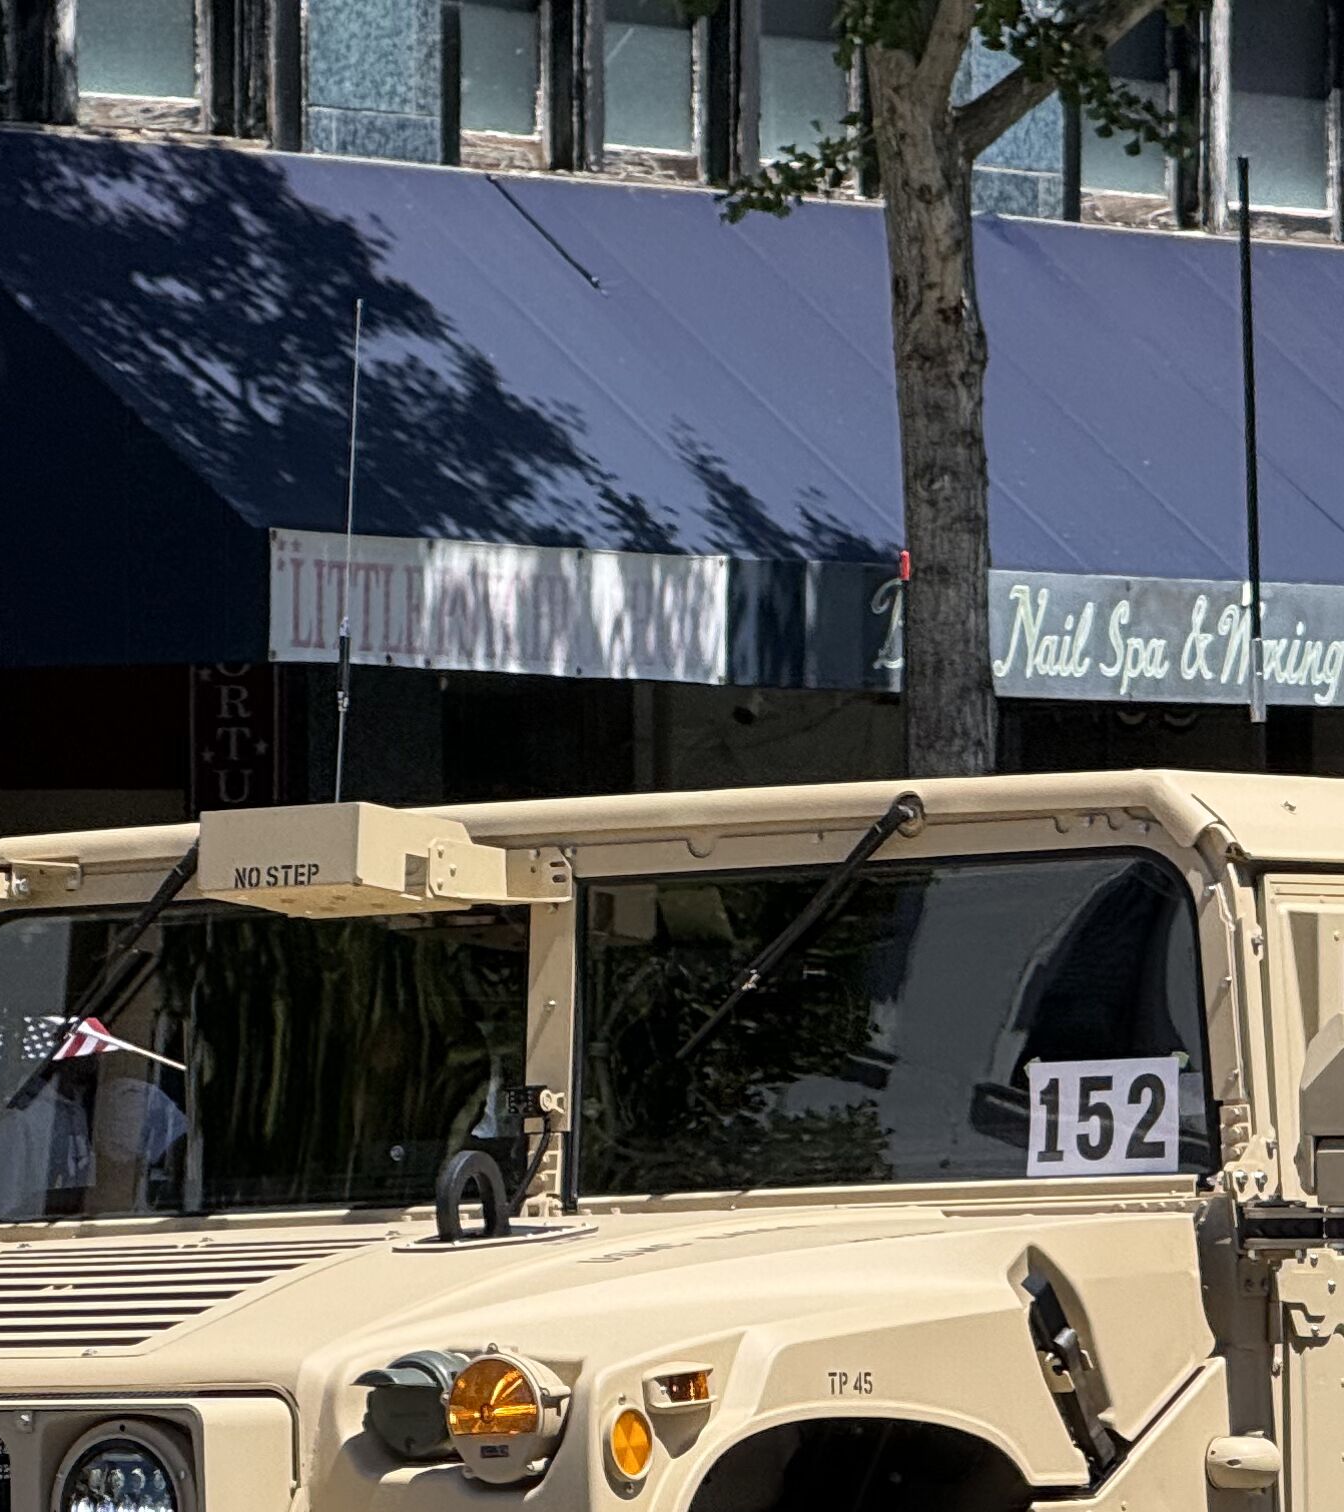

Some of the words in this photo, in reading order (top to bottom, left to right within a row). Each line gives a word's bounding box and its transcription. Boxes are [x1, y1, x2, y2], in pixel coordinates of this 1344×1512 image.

[290, 557, 424, 654] LITTLE
[994, 584, 1094, 679] Nail
[1099, 600, 1170, 695] Spa
[1181, 594, 1214, 681] &
[234, 866, 261, 889] NO
[265, 863, 320, 887] STEP
[1036, 1071, 1167, 1163] 152
[828, 1371, 849, 1396] TP
[853, 1371, 874, 1396] 45
